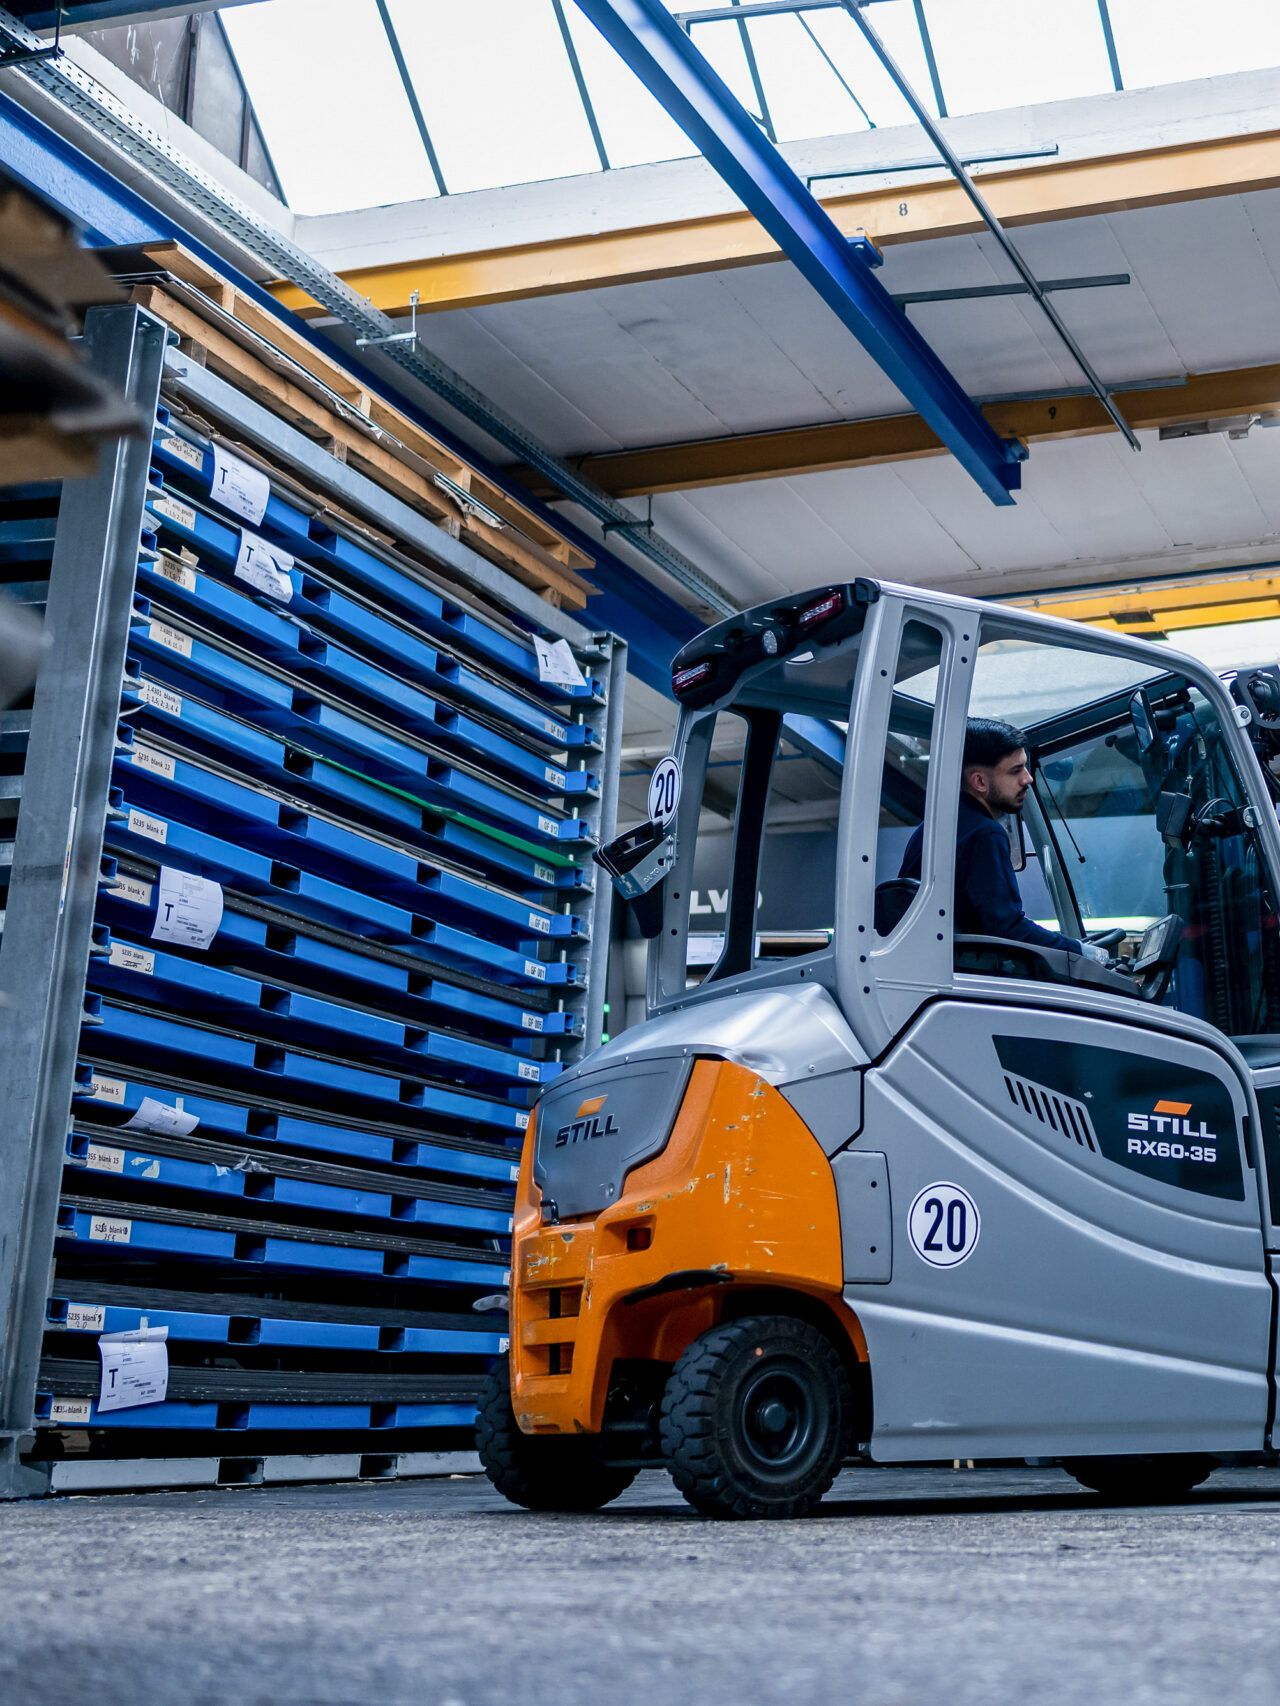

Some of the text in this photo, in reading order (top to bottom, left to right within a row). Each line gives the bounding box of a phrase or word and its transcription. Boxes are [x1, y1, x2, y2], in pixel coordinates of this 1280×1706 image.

[898, 202, 908, 216] 8
[1048, 406, 1057, 420] 9
[220, 466, 229, 485] T
[246, 545, 255, 563] T
[541, 653, 548, 668] T
[151, 757, 164, 768] blank
[654, 768, 675, 818] 20
[133, 818, 144, 828] S235
[146, 823, 159, 834] blank
[128, 886, 141, 896] blank
[165, 902, 174, 921] T
[101, 1083, 115, 1094] blank
[555, 1113, 621, 1148] STILL
[1127, 1112, 1217, 1140] STILL
[98, 1154, 112, 1164] blank
[1127, 1138, 1217, 1163] RX60-35
[923, 1196, 967, 1253] 20
[108, 1368, 119, 1389] T
